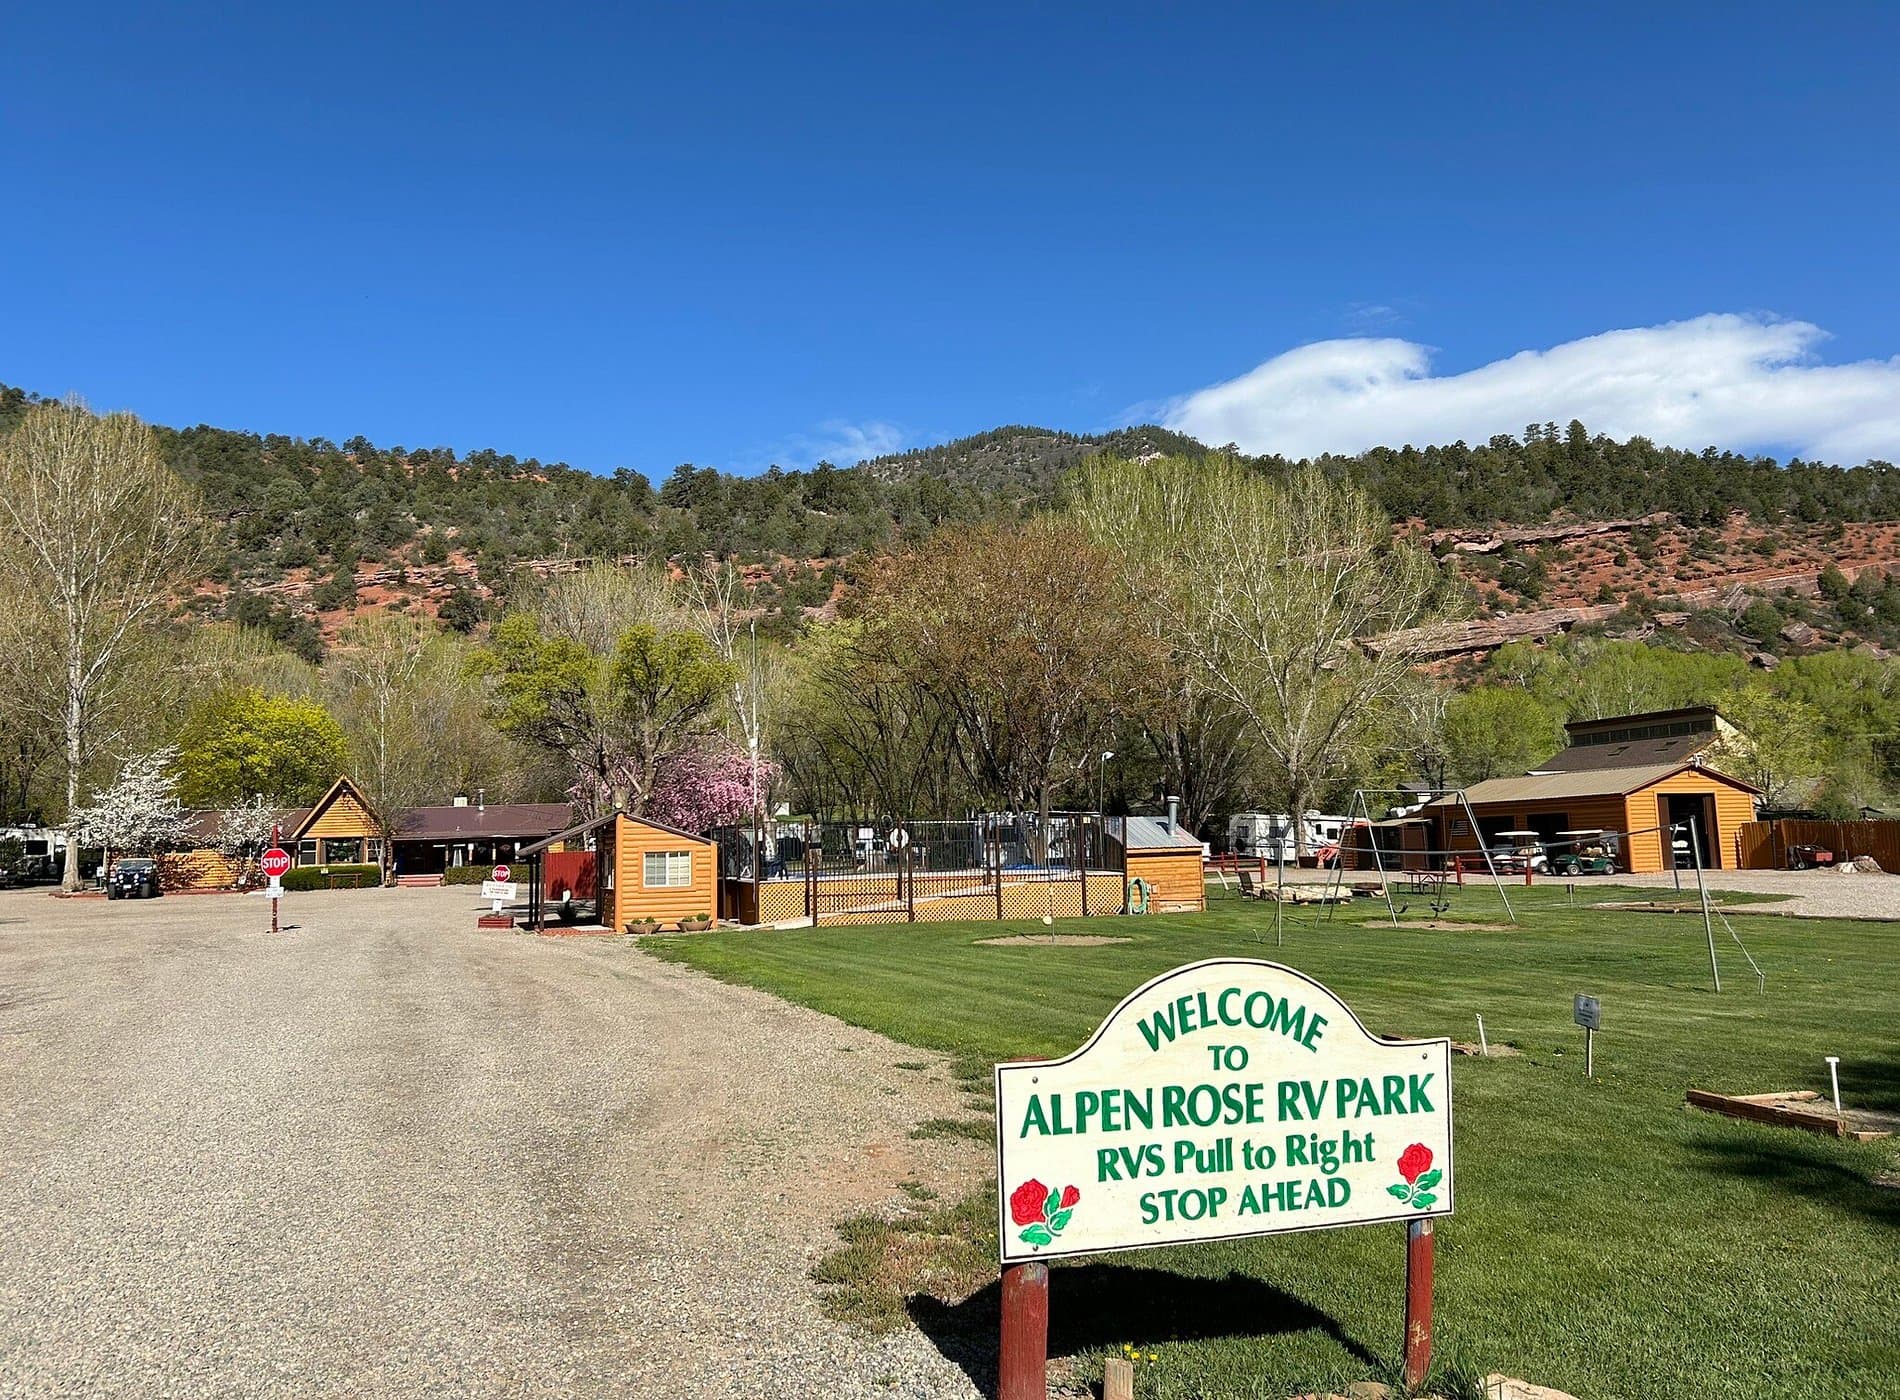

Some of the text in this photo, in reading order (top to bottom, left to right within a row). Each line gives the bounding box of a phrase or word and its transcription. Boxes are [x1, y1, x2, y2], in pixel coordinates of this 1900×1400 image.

[263, 857, 288, 869] STOP
[1137, 987, 1329, 1053] WELCOME
[1208, 1045, 1249, 1072] TO
[1020, 1072, 1436, 1138] ALPEN ROSE RV PARK
[1096, 1129, 1376, 1183] RVS Pull to Right
[1139, 1177, 1351, 1226] STOP AHEAD
